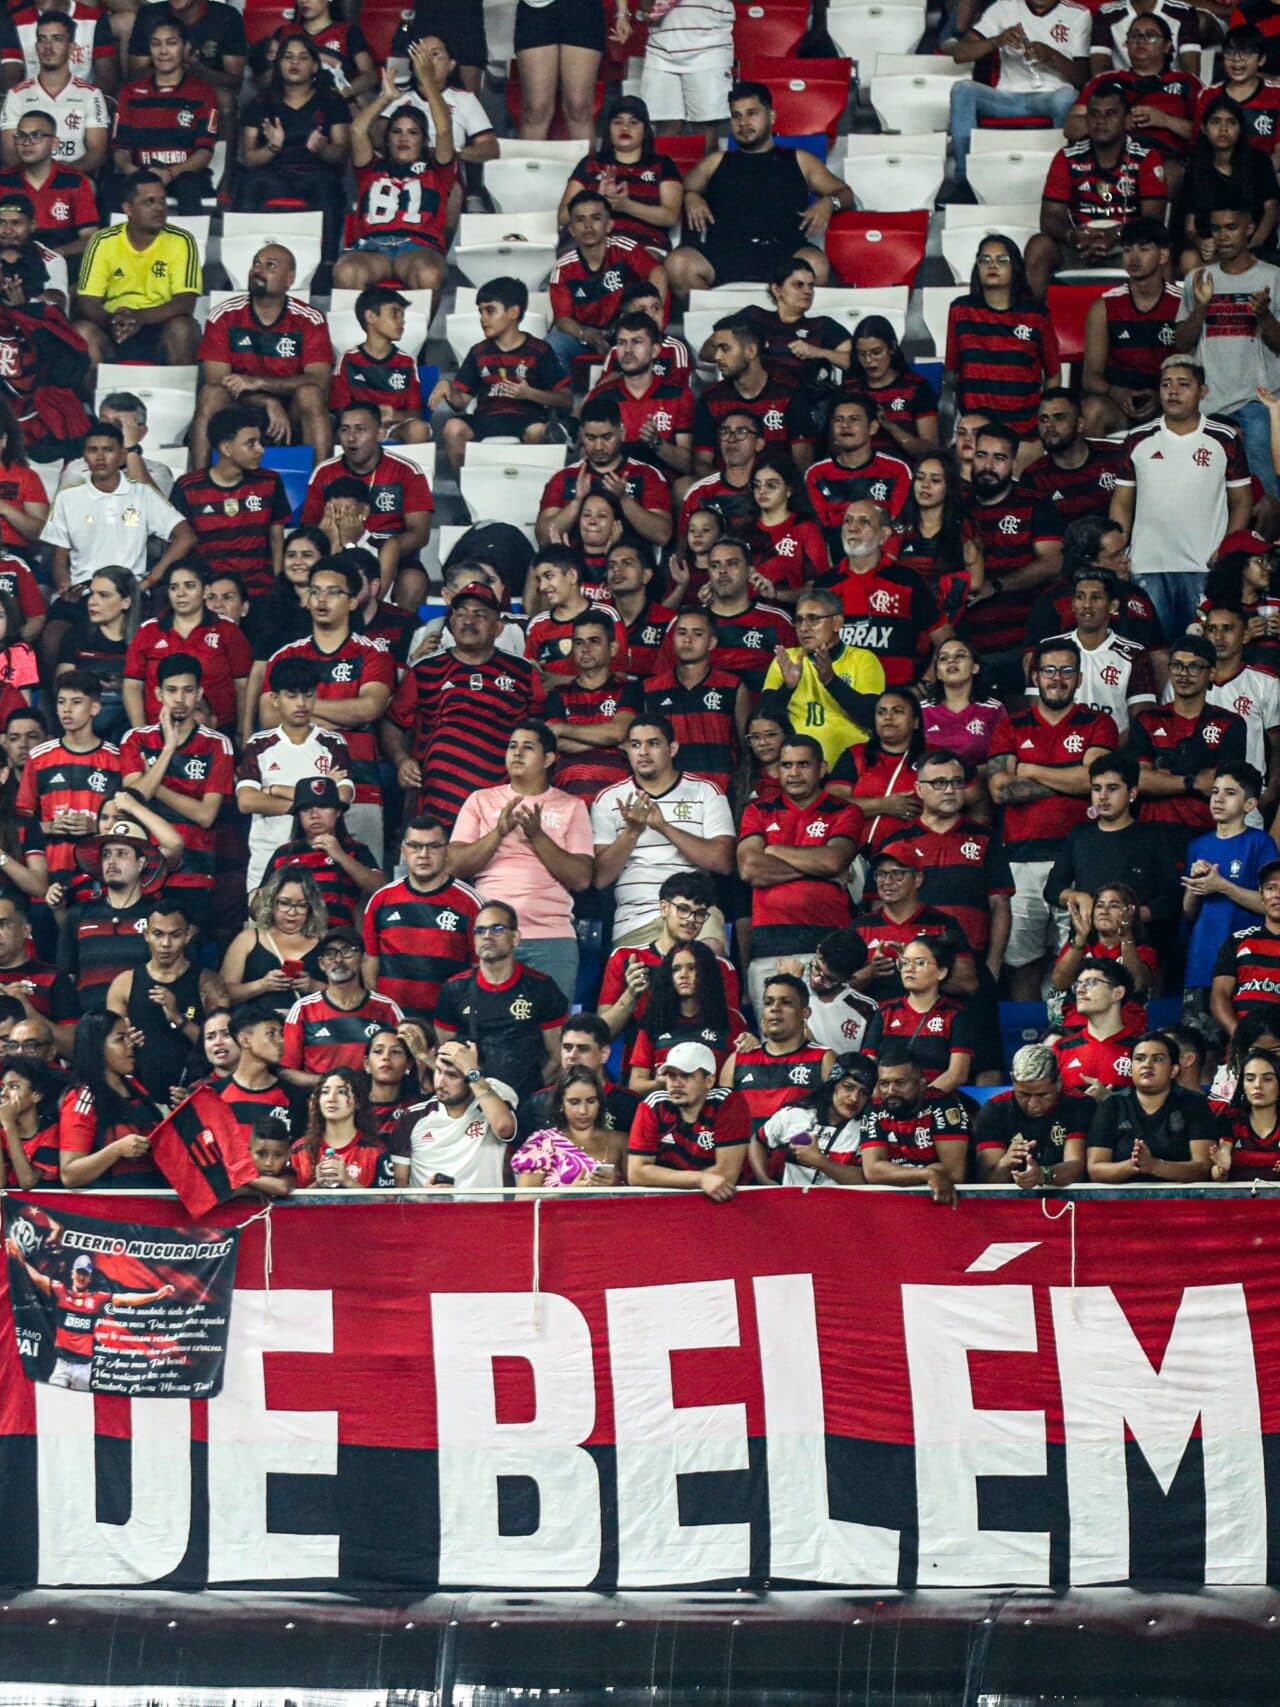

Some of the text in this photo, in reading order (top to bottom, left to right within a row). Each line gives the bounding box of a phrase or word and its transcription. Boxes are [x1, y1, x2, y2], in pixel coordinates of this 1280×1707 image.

[366, 178, 424, 223] 81
[805, 702, 825, 727] 10
[62, 1231, 126, 1255] ETERNO
[127, 1240, 198, 1260] MUCURA
[430, 1241, 1268, 1589] BELÉM
